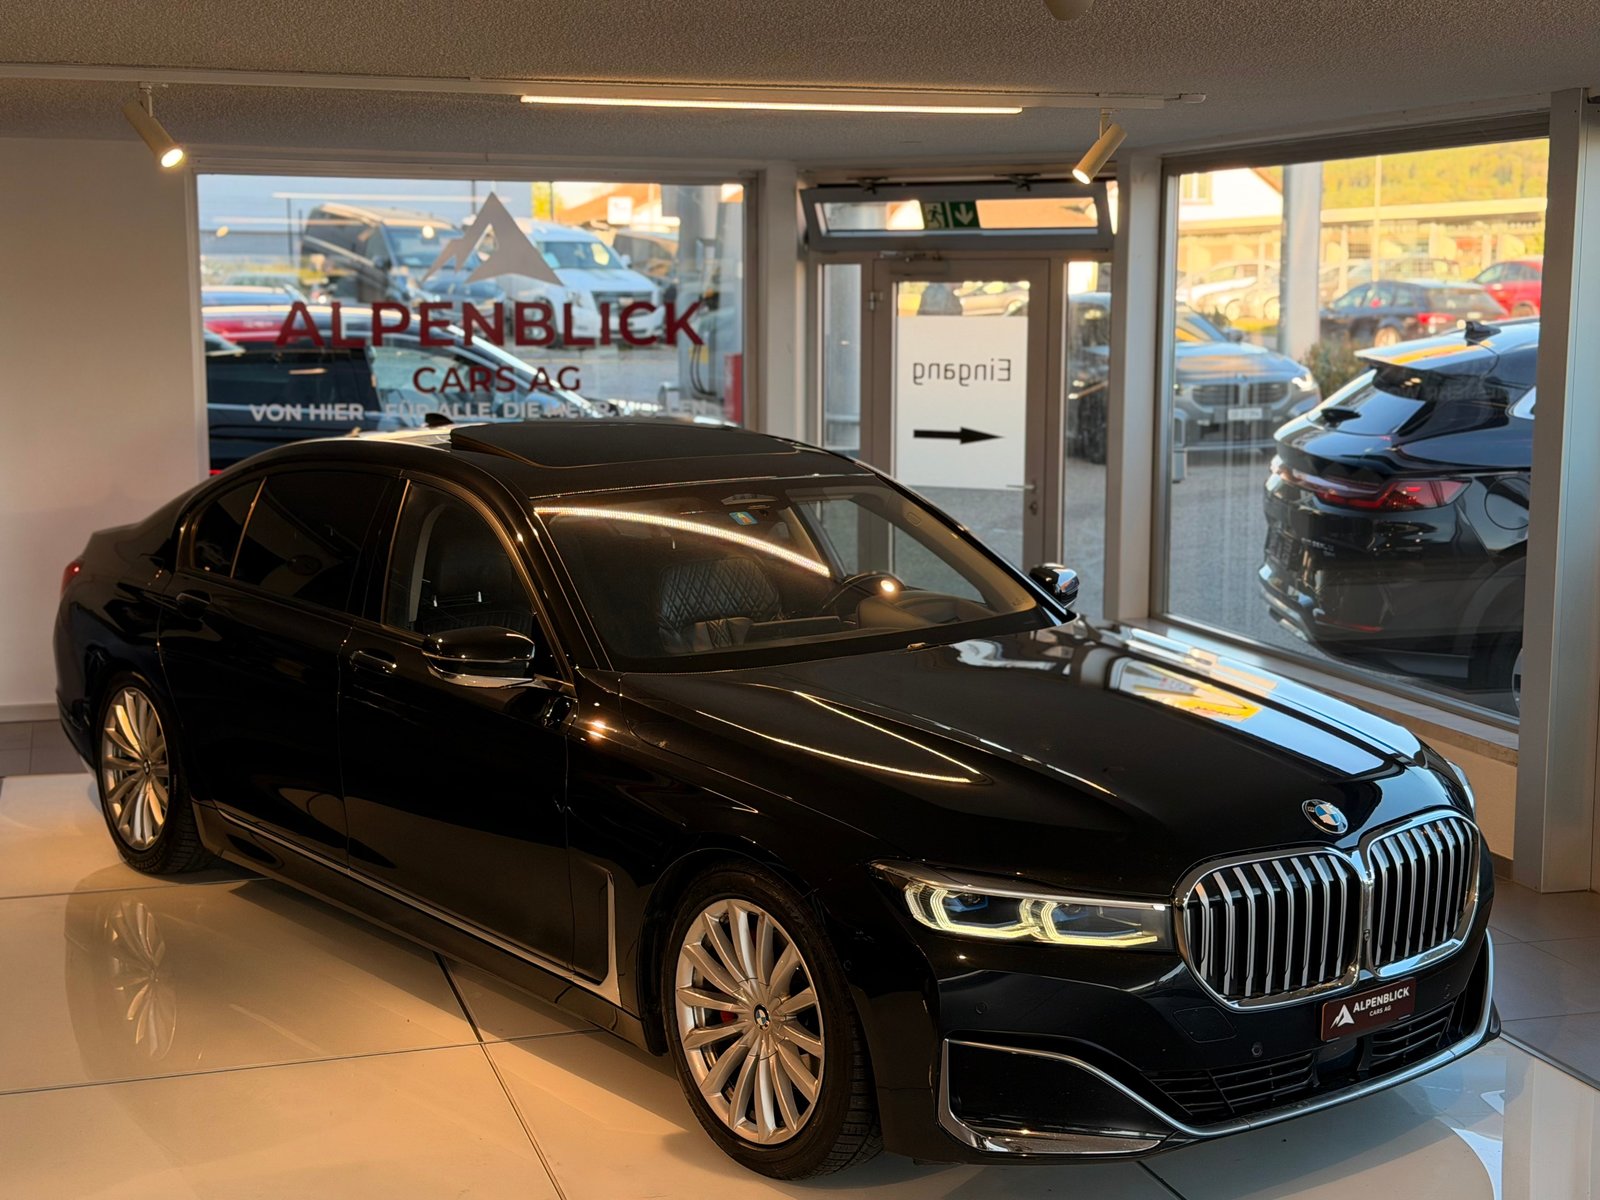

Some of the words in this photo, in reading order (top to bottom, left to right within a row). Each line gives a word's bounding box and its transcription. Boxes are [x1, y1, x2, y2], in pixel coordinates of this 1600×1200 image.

[275, 302, 704, 347] ALPENBLICK
[413, 366, 517, 394] CARS
[528, 366, 581, 393] AG
[250, 402, 302, 422] VON
[308, 402, 365, 421] HIER
[502, 402, 540, 418] DIE
[1352, 986, 1411, 1014] ALPENBLICK
[1369, 1006, 1384, 1017] CARS
[1384, 1004, 1392, 1012] AG
